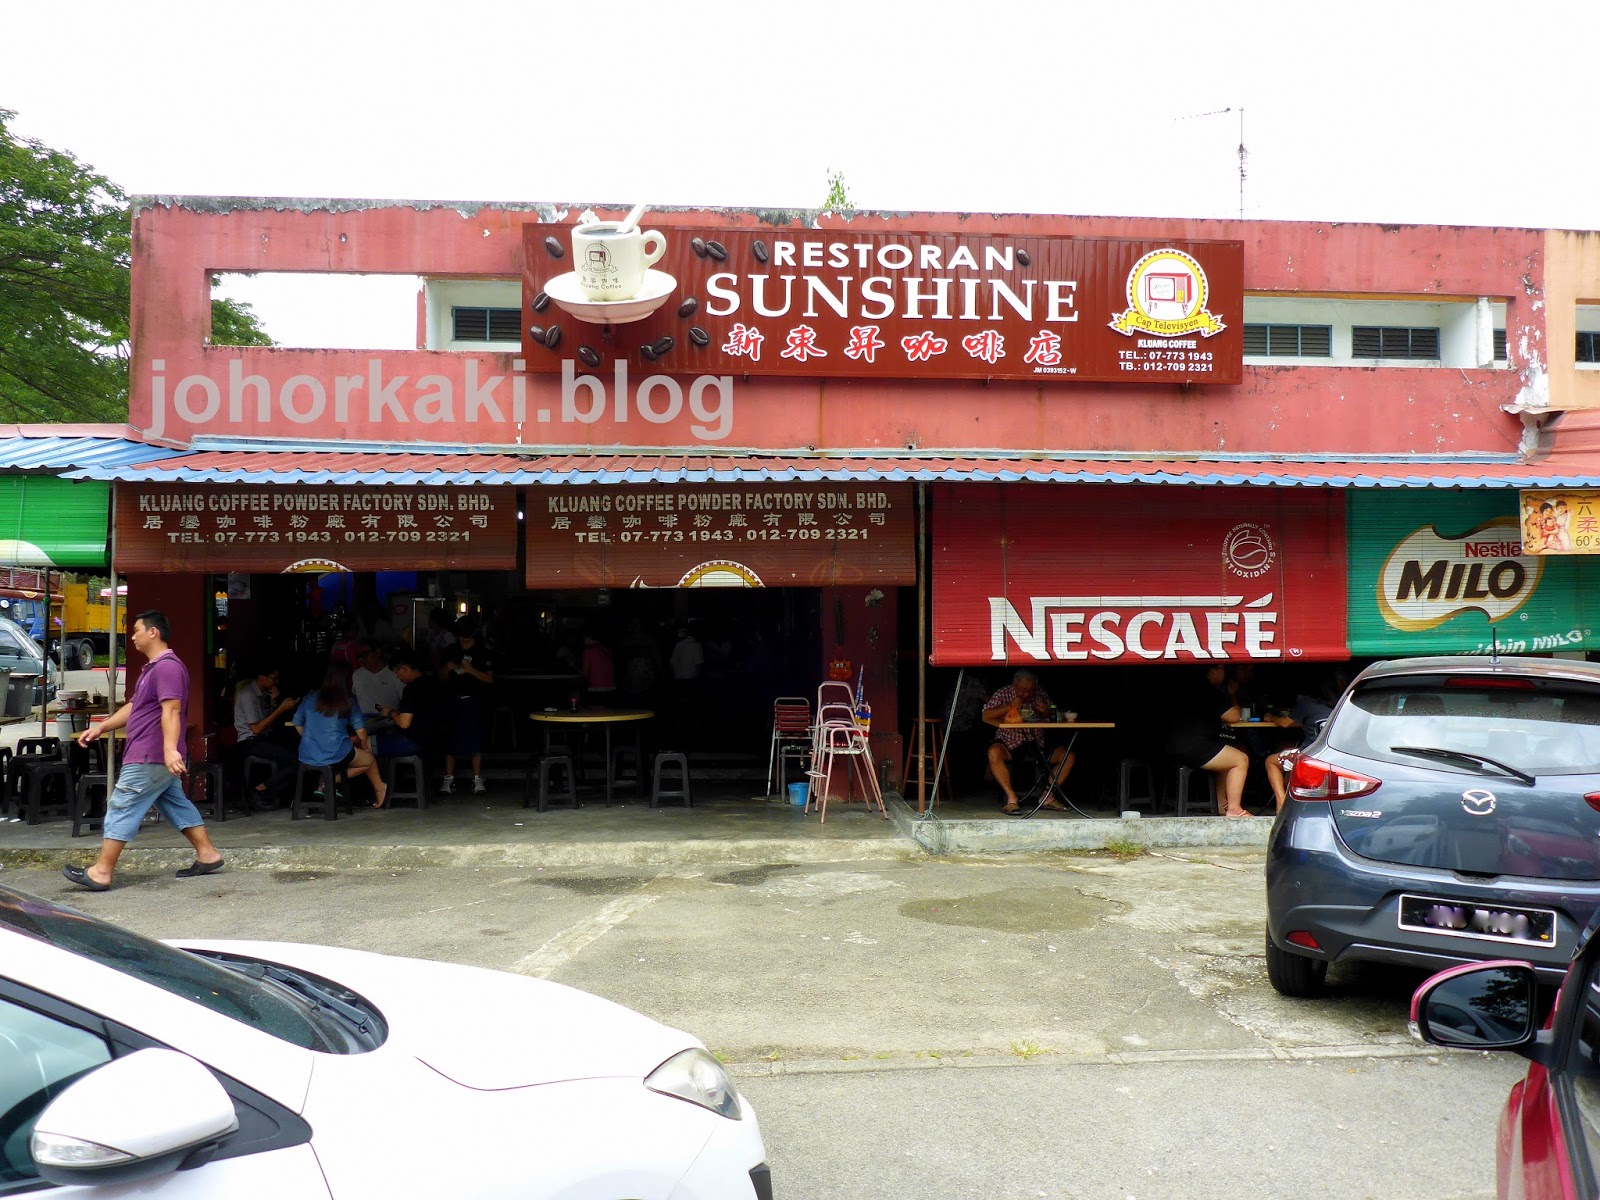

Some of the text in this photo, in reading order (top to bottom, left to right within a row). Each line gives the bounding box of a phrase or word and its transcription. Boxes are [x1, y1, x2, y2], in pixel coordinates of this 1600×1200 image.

[773, 241, 1013, 271] RESTORAN
[705, 273, 1078, 323] SUNSHINE
[1136, 315, 1198, 330] Cap Televisyen
[1138, 339, 1196, 349] KLUANG COFFEE
[1149, 352, 1185, 360] 07-773
[1188, 352, 1213, 361] 1943
[1143, 362, 1186, 371] 012-709
[1188, 363, 1213, 372] 2321
[139, 494, 495, 512] KLUANG COFFEE POWDER FACTORY SDN. BHD.
[548, 491, 892, 513] KLUANG COFFEE POWDER FACTORY SDN. BHD.
[167, 532, 209, 543] TEL:
[214, 531, 280, 543] 07-773
[344, 531, 421, 543] 012-709
[426, 531, 470, 542] 2321
[575, 532, 616, 543] TEL:
[620, 530, 684, 542] 07-773
[746, 528, 821, 541] 012-709
[825, 528, 869, 540] 2321
[1395, 559, 1525, 600] MILO
[987, 591, 1282, 661] NESCAFÉ
[1532, 629, 1583, 651] MILO
